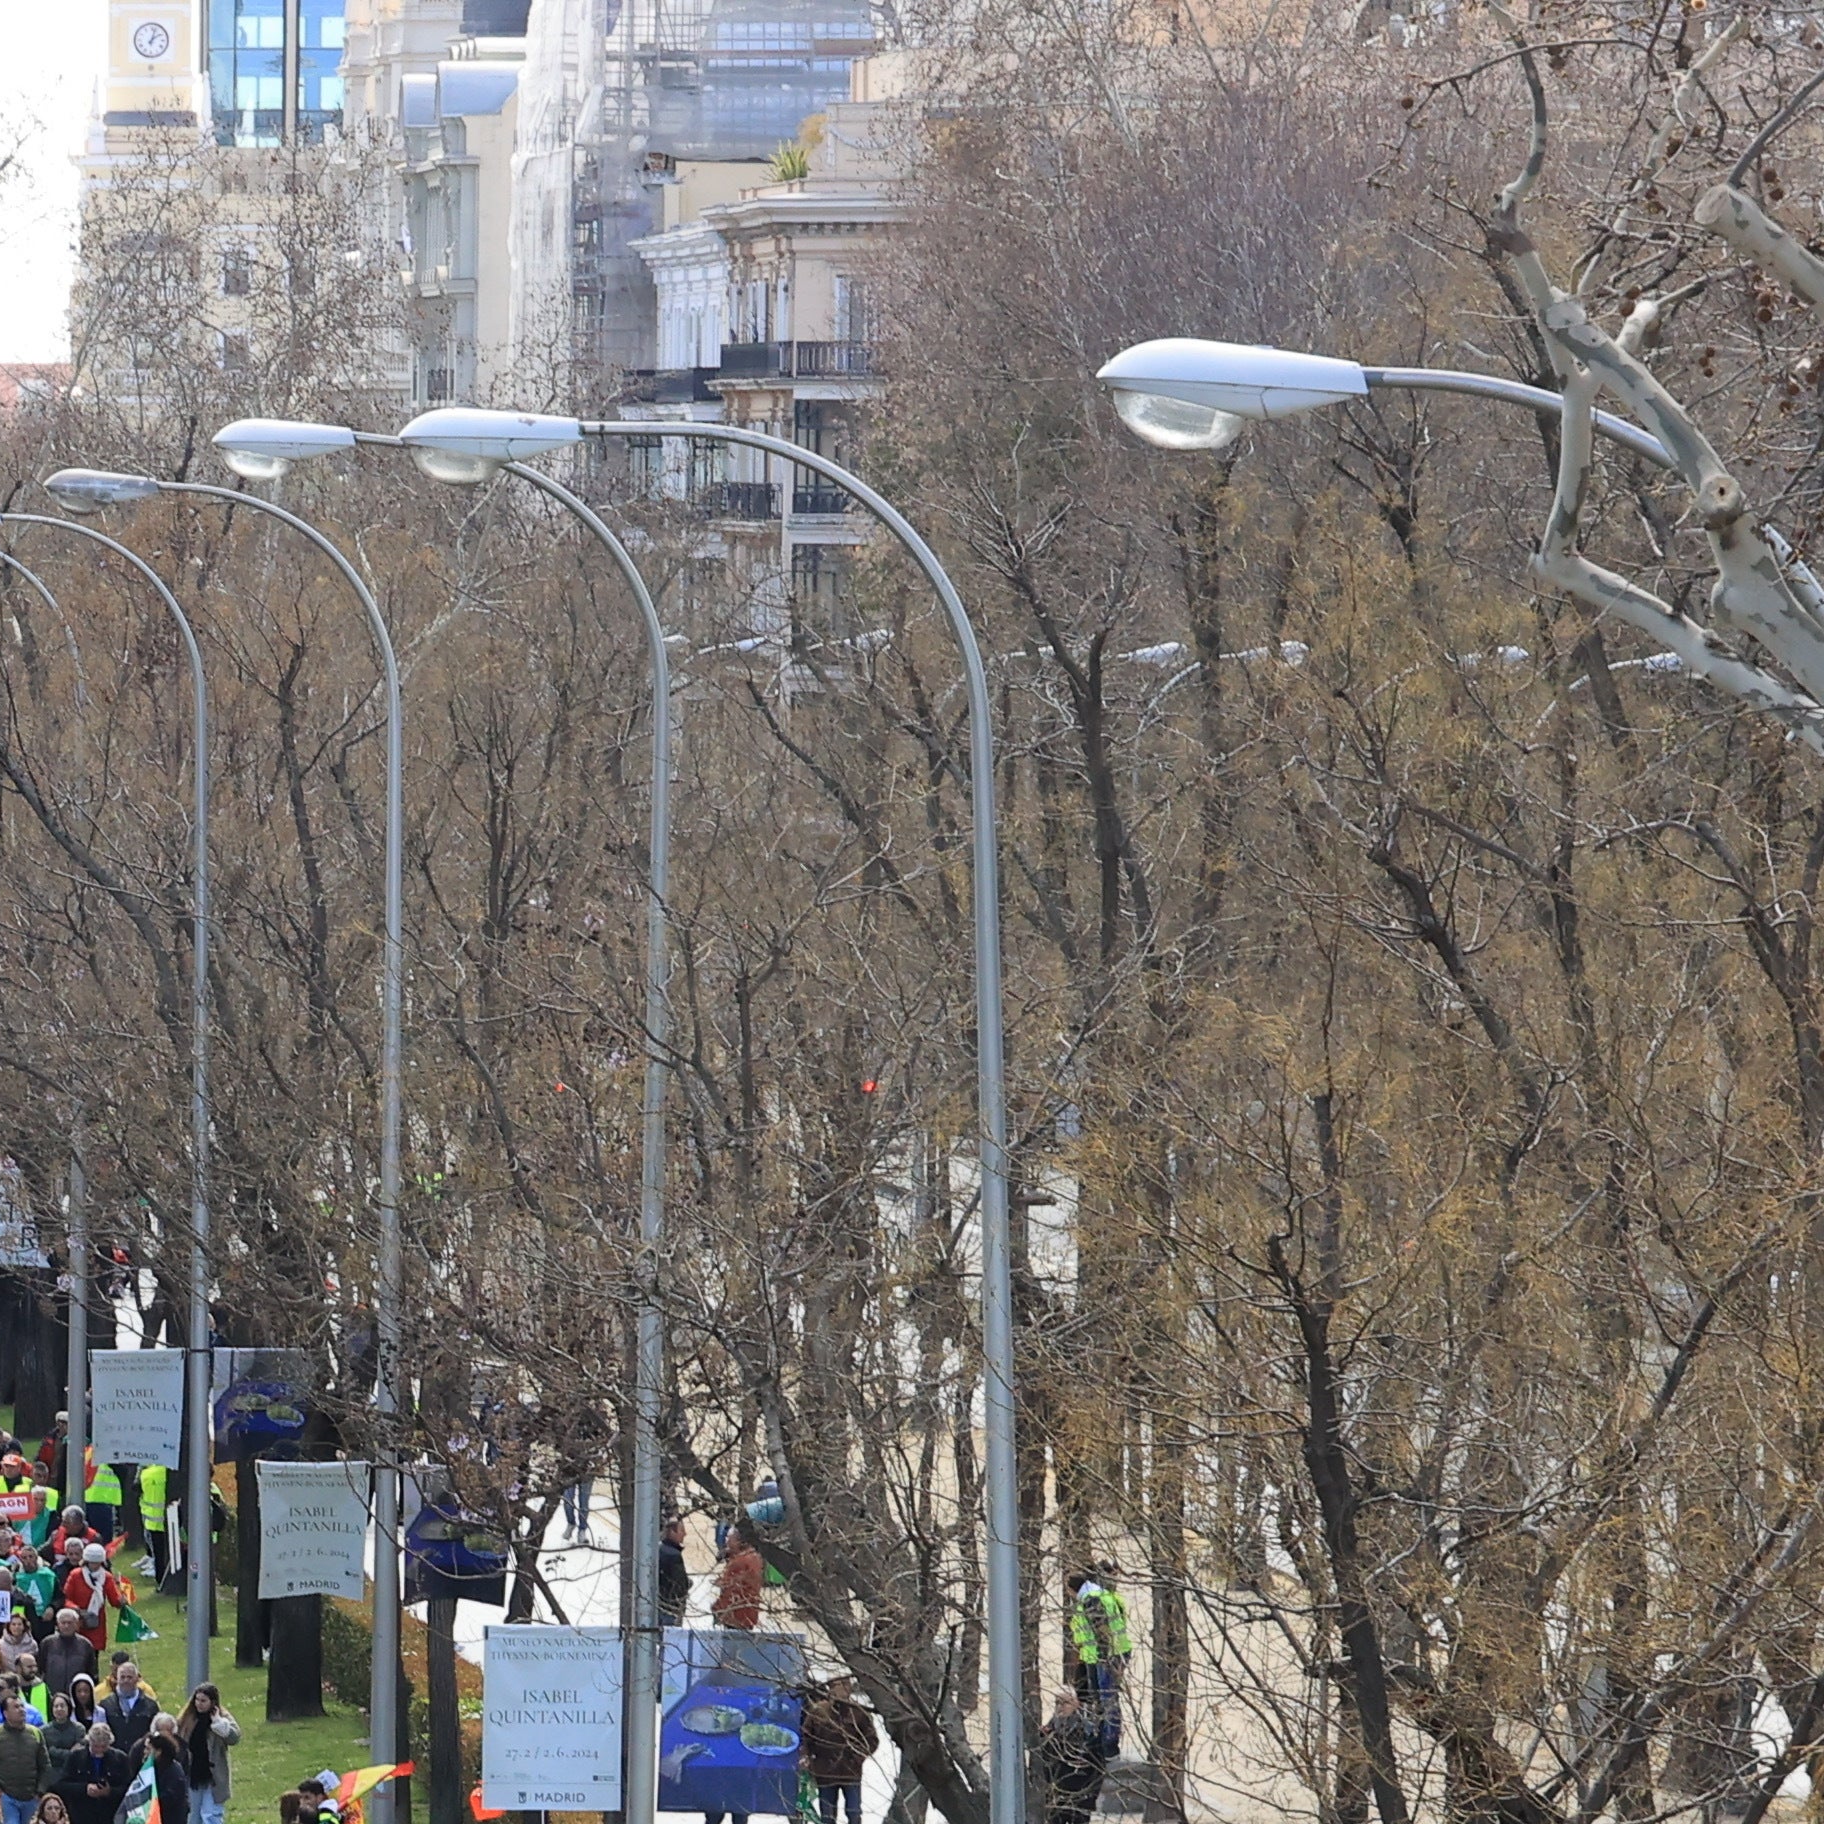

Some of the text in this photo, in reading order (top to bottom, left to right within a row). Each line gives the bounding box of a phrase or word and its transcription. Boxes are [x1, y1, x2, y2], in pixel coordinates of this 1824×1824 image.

[114, 1387, 156, 1399] ISABEL
[95, 1399, 179, 1415] QUINTANILLA
[122, 1450, 159, 1461] MADRID
[289, 1504, 338, 1518] ISABEL
[264, 1518, 363, 1538] QUINTANILLA
[298, 1580, 341, 1592] MADRID
[521, 1688, 583, 1707] ISABEL
[489, 1708, 615, 1729] QUINTANILLA
[535, 1792, 586, 1803] MADRID
